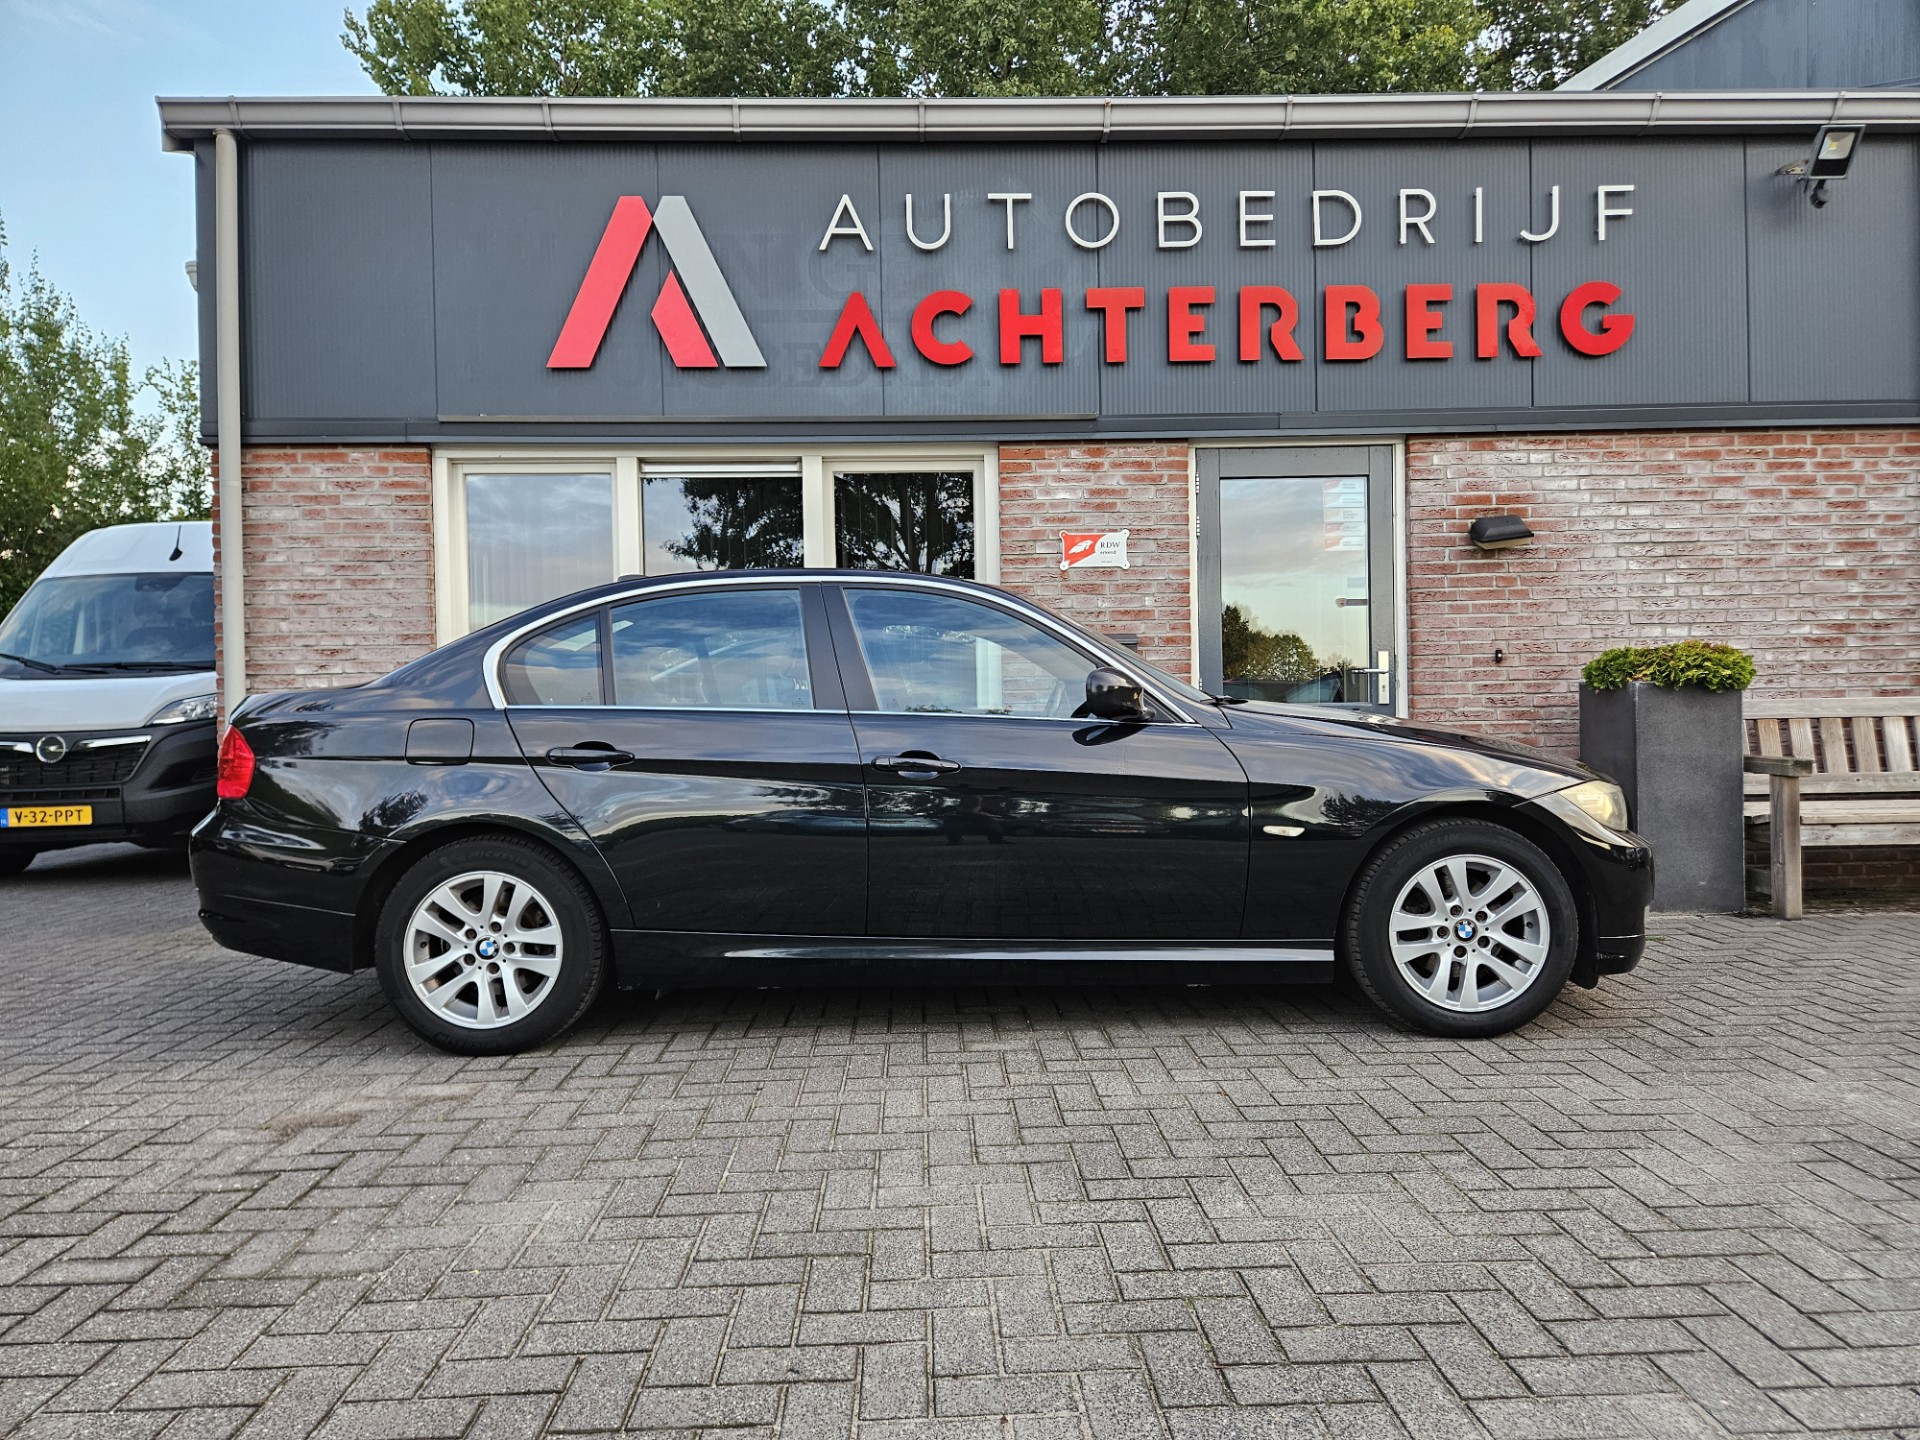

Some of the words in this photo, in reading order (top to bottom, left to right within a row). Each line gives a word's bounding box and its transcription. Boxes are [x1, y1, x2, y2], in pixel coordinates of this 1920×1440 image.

[818, 185, 1635, 251] AUTOBEDRIJF
[818, 281, 1635, 368] ACHTERBERG
[1100, 541, 1121, 549] RDW
[14, 809, 84, 823] V-32-PPT
